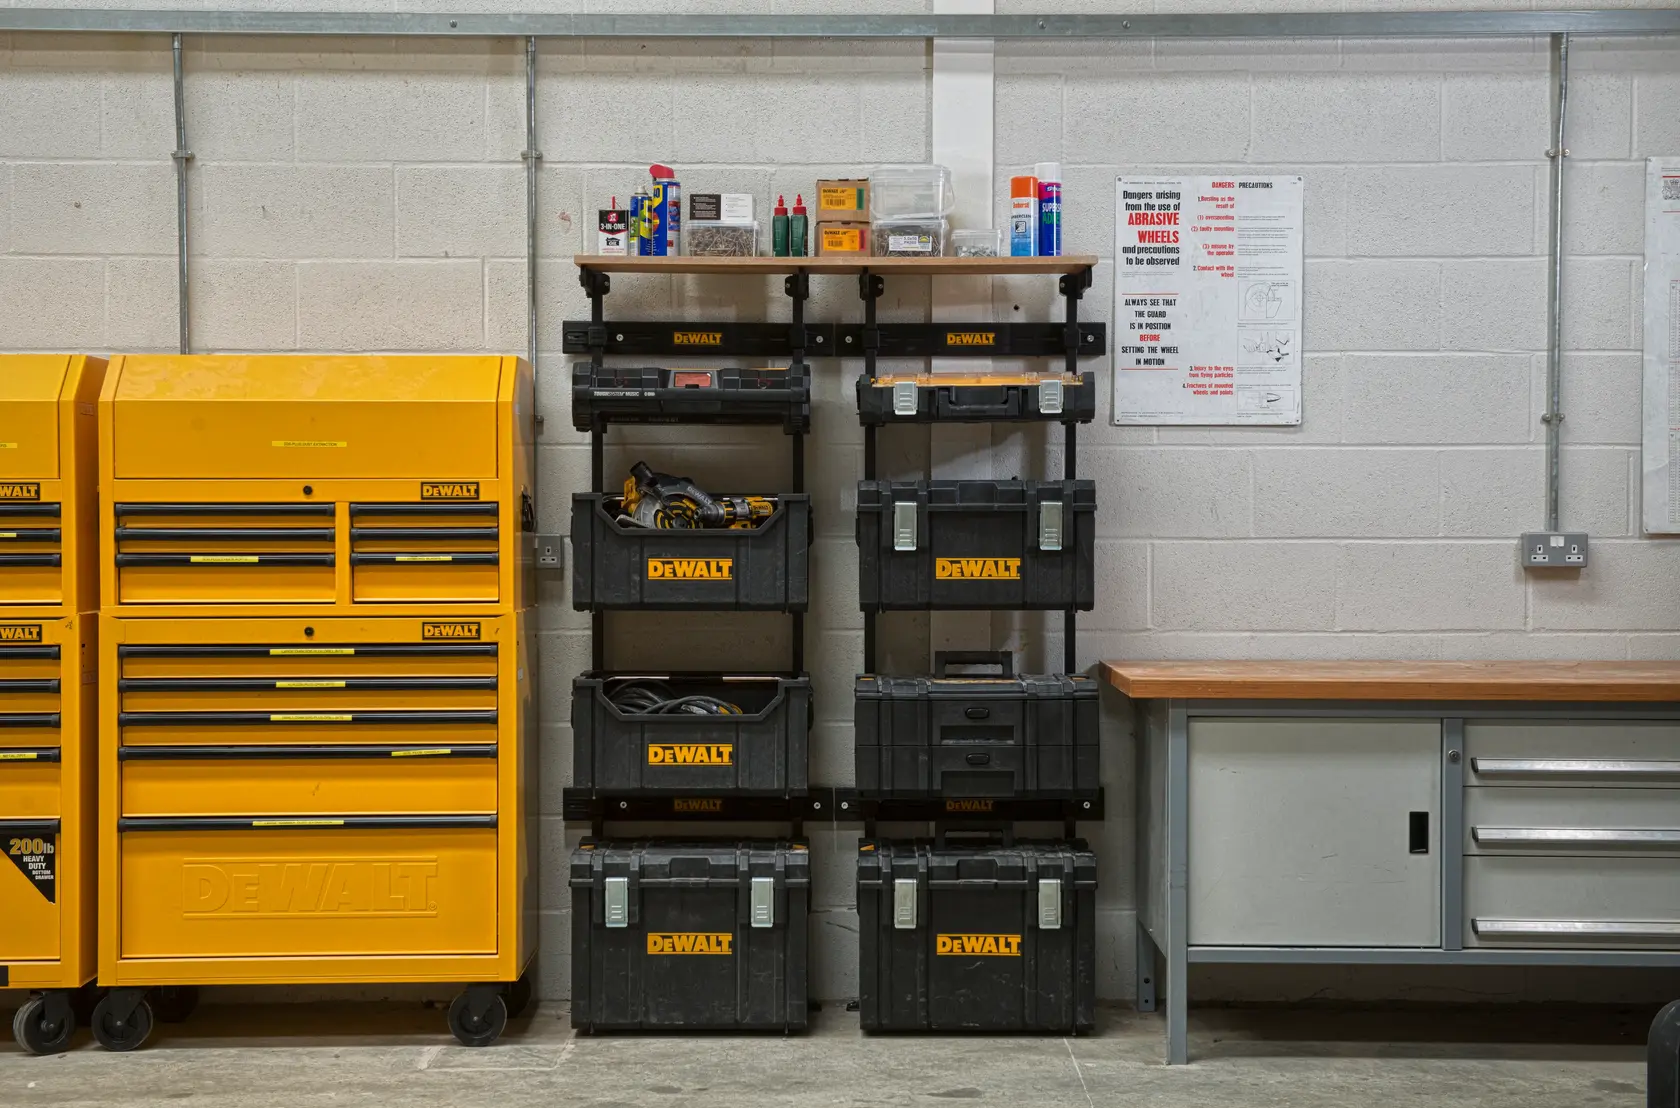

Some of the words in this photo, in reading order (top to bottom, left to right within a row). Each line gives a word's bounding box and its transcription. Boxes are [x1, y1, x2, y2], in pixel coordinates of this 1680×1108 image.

[1123, 190, 1152, 200] Dangers
[1156, 190, 1180, 200] arising
[1125, 202, 1142, 211] from
[1144, 202, 1156, 211] the
[1173, 202, 1180, 211] of
[1128, 212, 1179, 225] ABRASIVE
[1138, 230, 1179, 243] WHEELS
[1122, 245, 1136, 254] and
[1137, 245, 1180, 254] precautions
[1126, 257, 1133, 265] to
[1135, 257, 1144, 265] be
[1146, 257, 1180, 265] observed
[0, 486, 37, 497] WALT
[649, 560, 732, 578] DEWALT
[937, 560, 1020, 578] DEWALT
[0, 629, 39, 640] WALT
[649, 745, 732, 764] DEWALT
[10, 838, 54, 854] 200lb
[648, 935, 732, 952] DEWALT
[937, 936, 1021, 953] DEWALT
